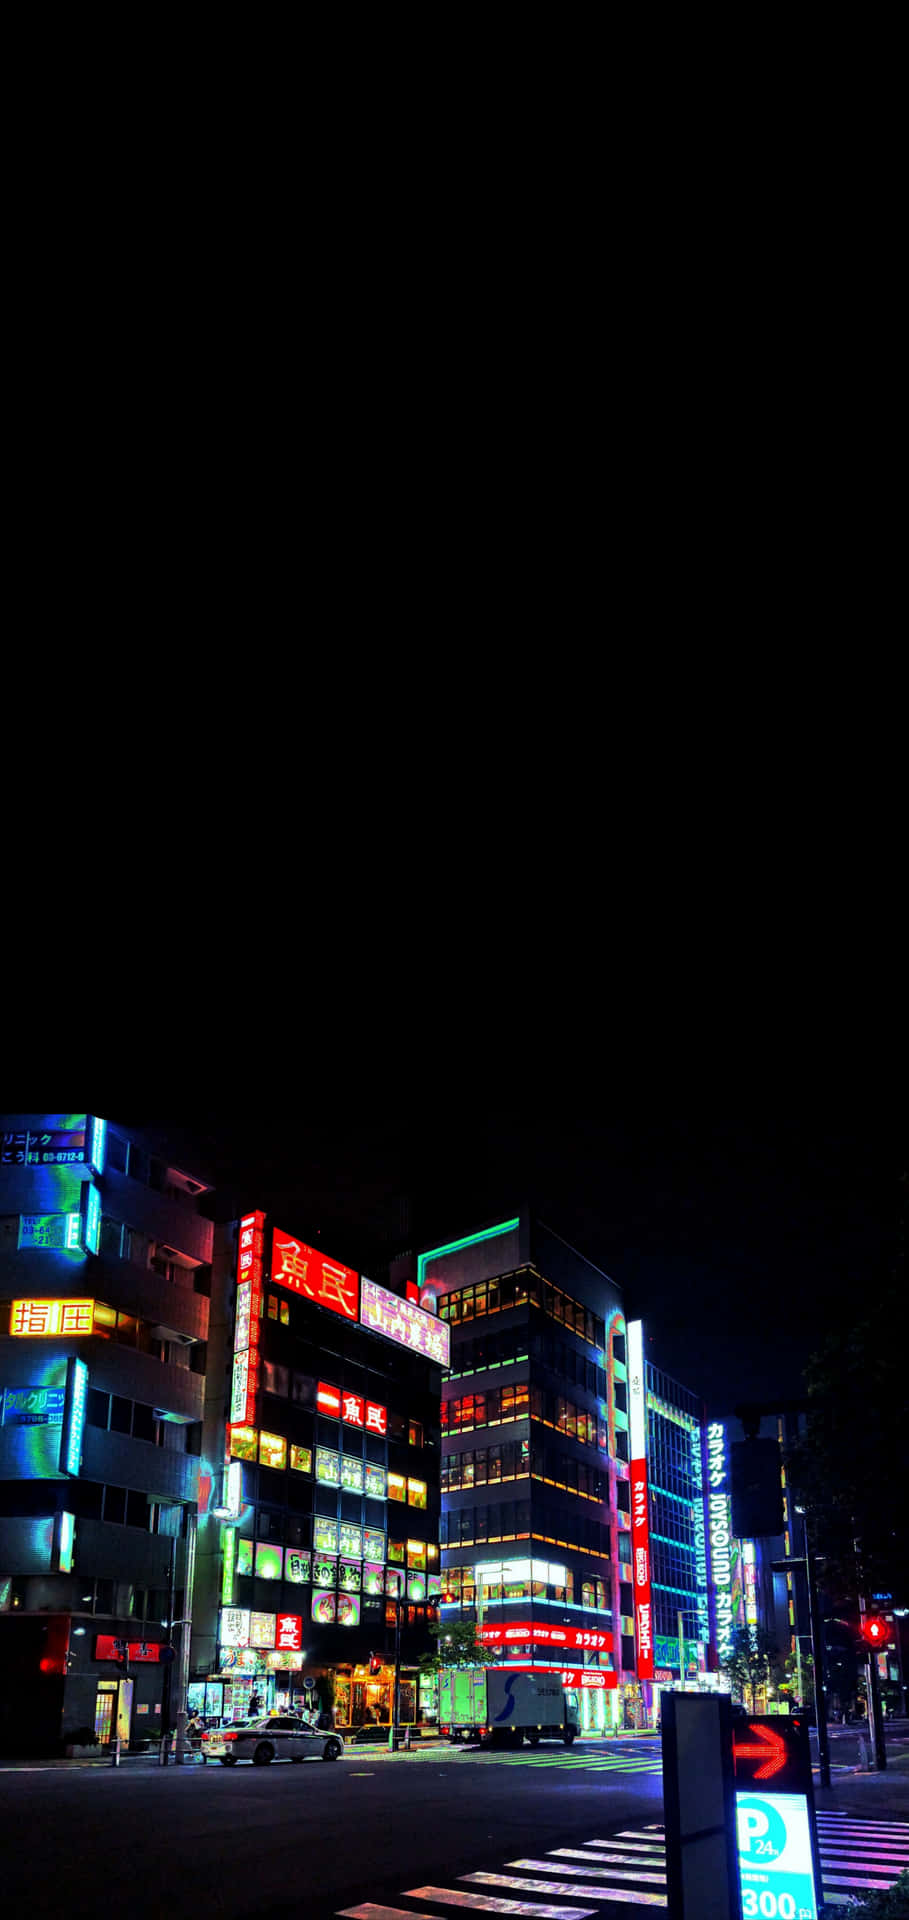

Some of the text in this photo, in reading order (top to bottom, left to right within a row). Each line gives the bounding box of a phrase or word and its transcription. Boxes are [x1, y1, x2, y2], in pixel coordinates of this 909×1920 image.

[275, 1241, 356, 1316] 魚民
[15, 1304, 91, 1333] 指圧
[343, 1397, 386, 1433] 魚民
[708, 1423, 727, 1487] カラオケ
[634, 1481, 646, 1527] カラオケ
[710, 1494, 731, 1585] JOYSOUND
[280, 1617, 299, 1649] 魚民
[575, 1632, 606, 1646] カラオケ
[738, 1807, 769, 1851] P
